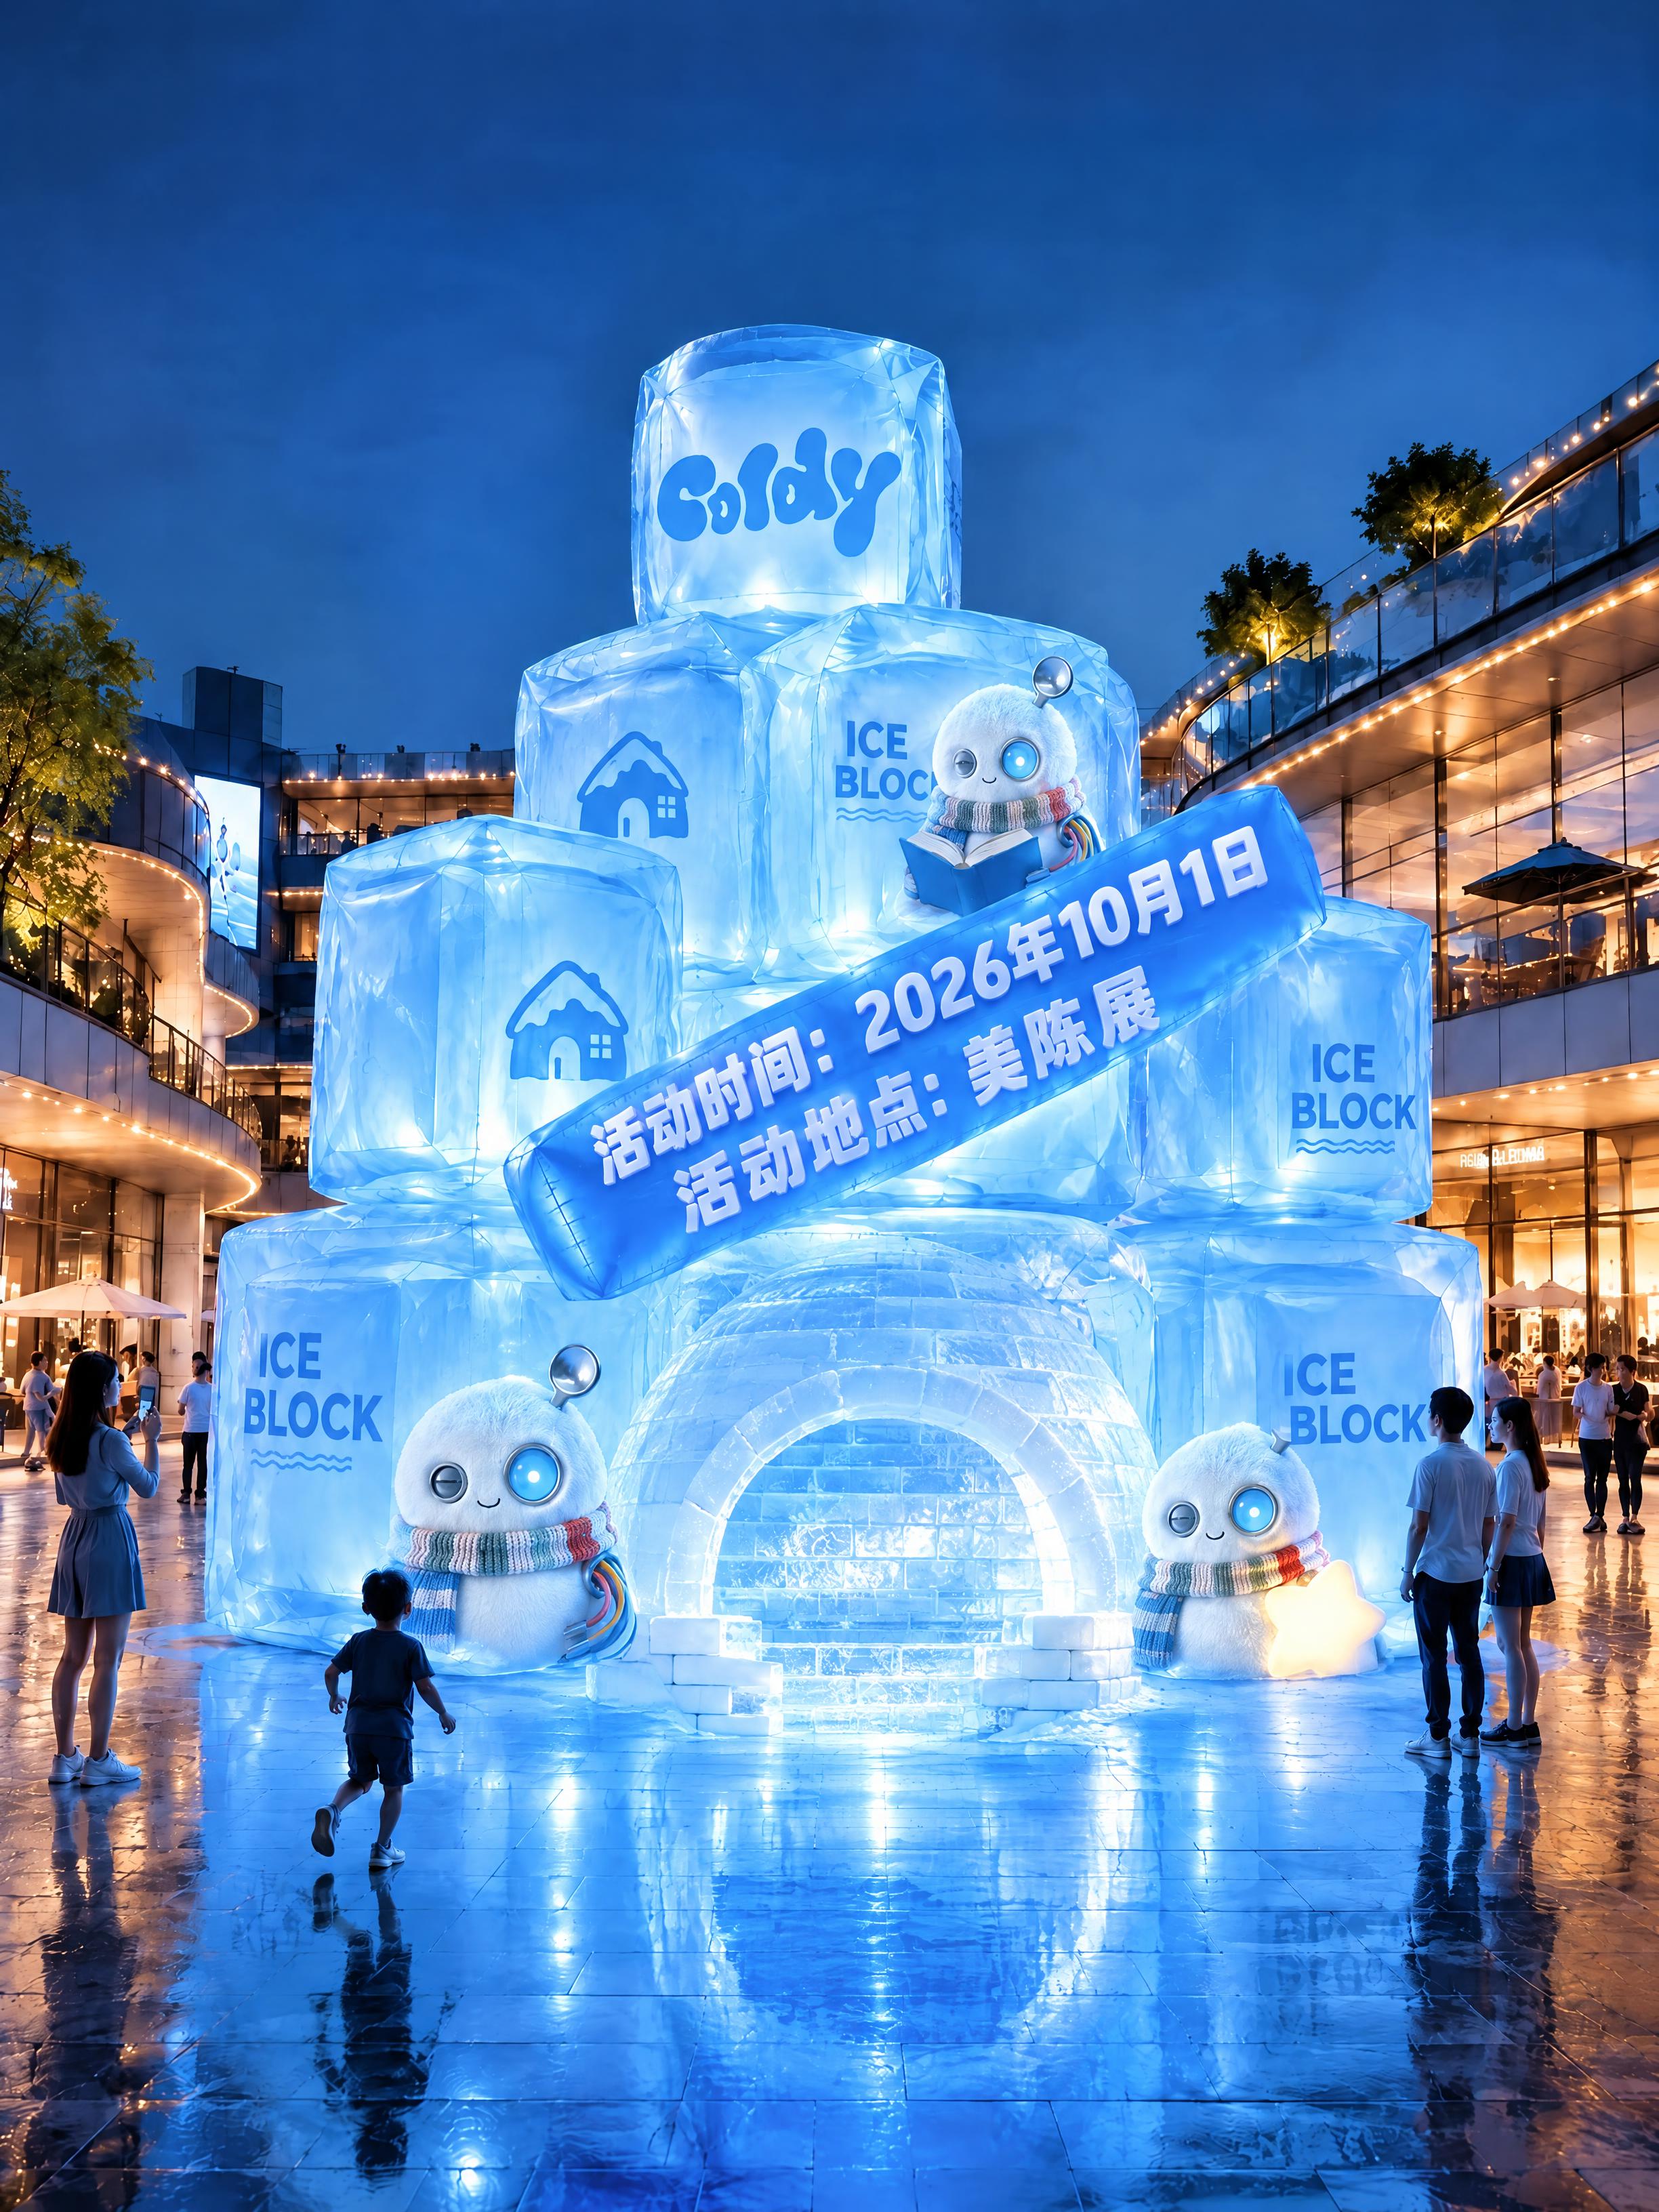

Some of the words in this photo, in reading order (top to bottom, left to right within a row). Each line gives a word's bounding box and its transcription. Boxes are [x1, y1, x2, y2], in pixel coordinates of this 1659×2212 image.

[657, 427, 901, 558] Coldy
[846, 720, 908, 760] ICE
[835, 764, 939, 802] BLOC
[1312, 1043, 1375, 1083] ICE
[1291, 1092, 1417, 1130] BLOCK
[259, 1332, 322, 1380] ICE
[1284, 1353, 1356, 1396] ICE
[243, 1388, 383, 1442] BLOCK
[1290, 1404, 1427, 1445] BLOCK
